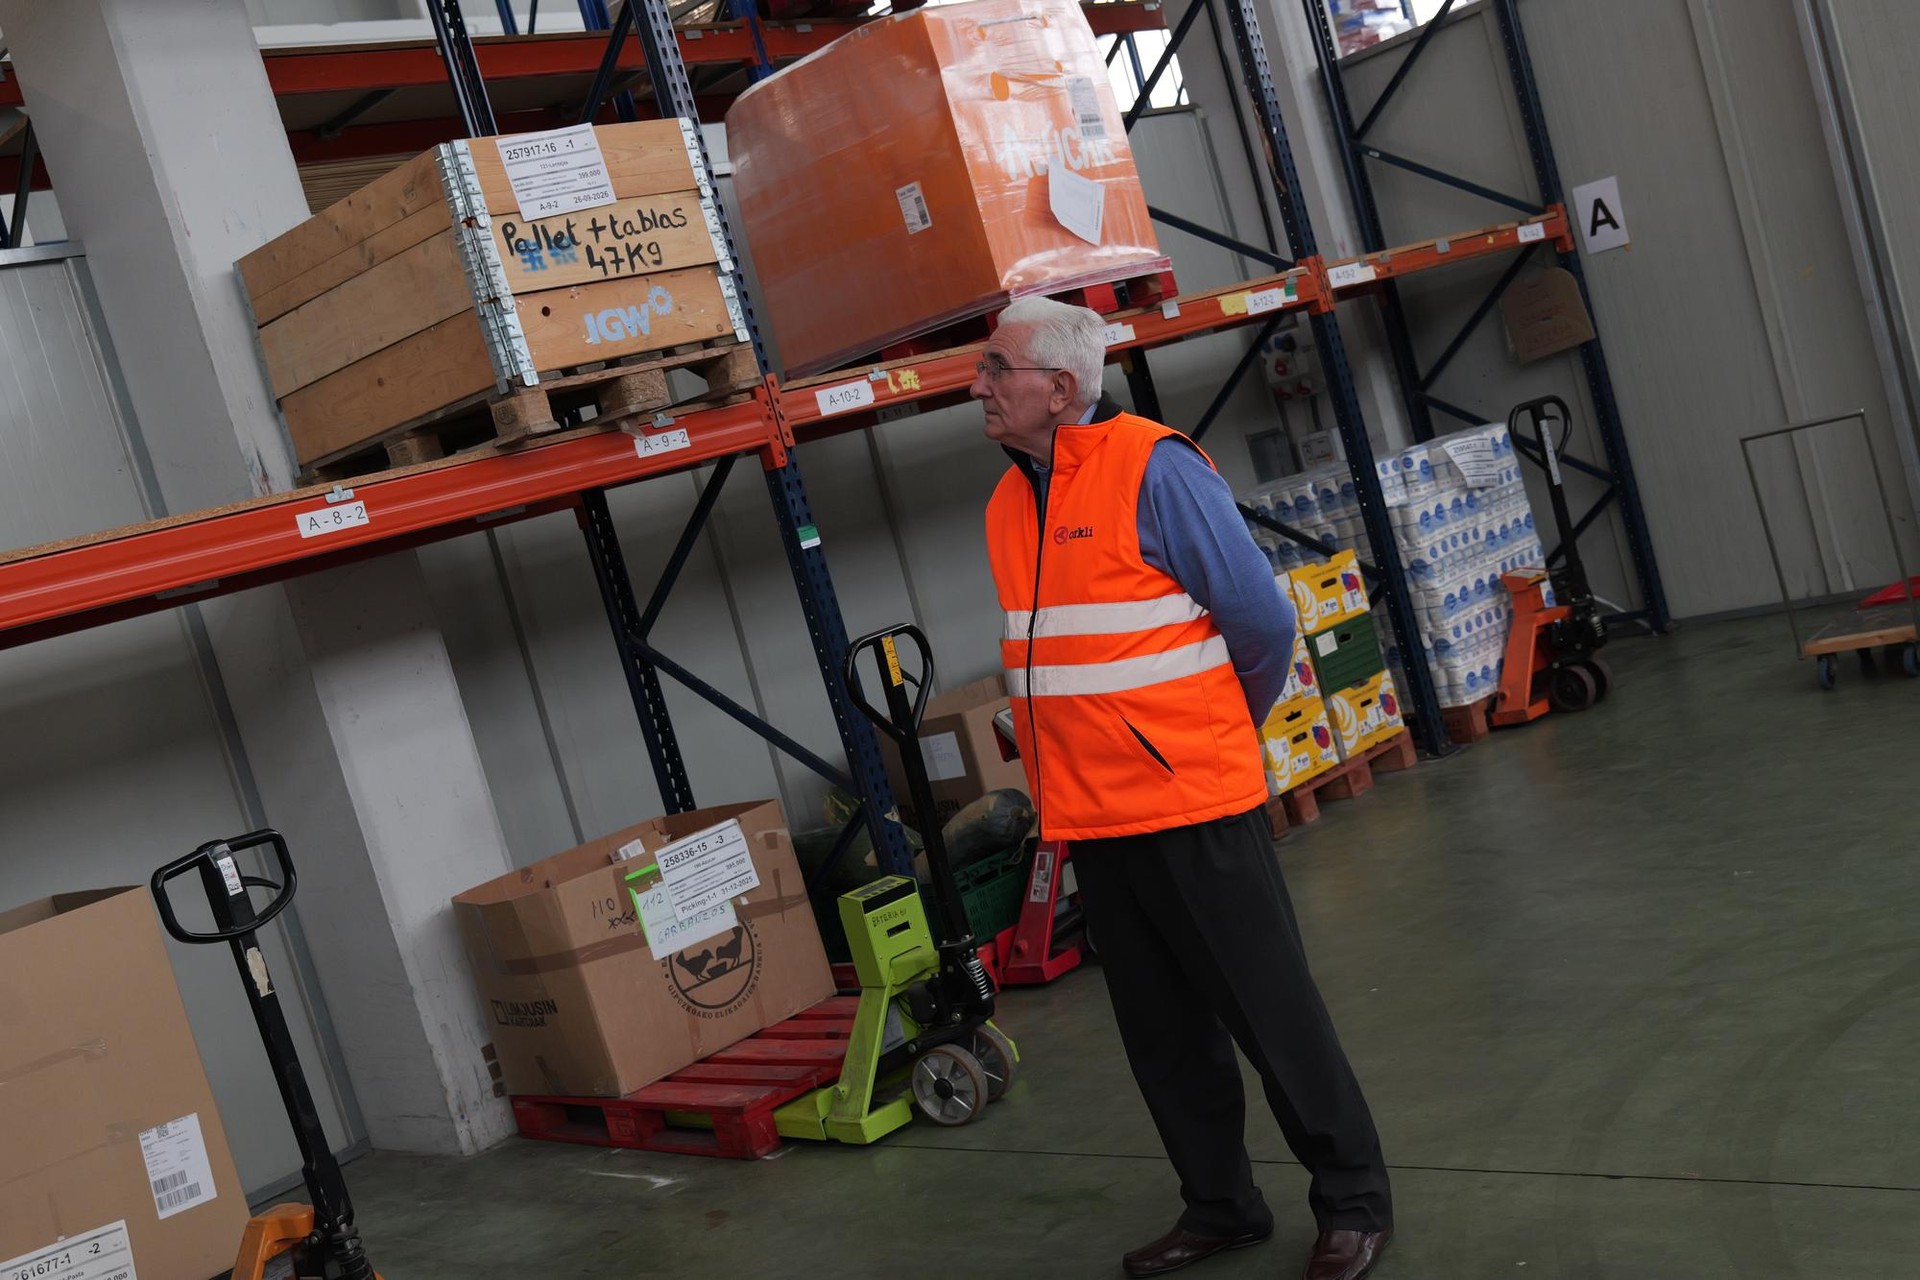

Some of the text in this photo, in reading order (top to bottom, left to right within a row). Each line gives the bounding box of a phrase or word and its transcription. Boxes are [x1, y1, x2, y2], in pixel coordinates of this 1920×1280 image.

[506, 142, 557, 161] 257917-16
[1590, 197, 1620, 237] A
[502, 217, 581, 256] Pallet
[829, 388, 861, 406] A-10-2
[663, 835, 725, 869] 258336-15 -3
[681, 892, 718, 914] Picking-1-1
